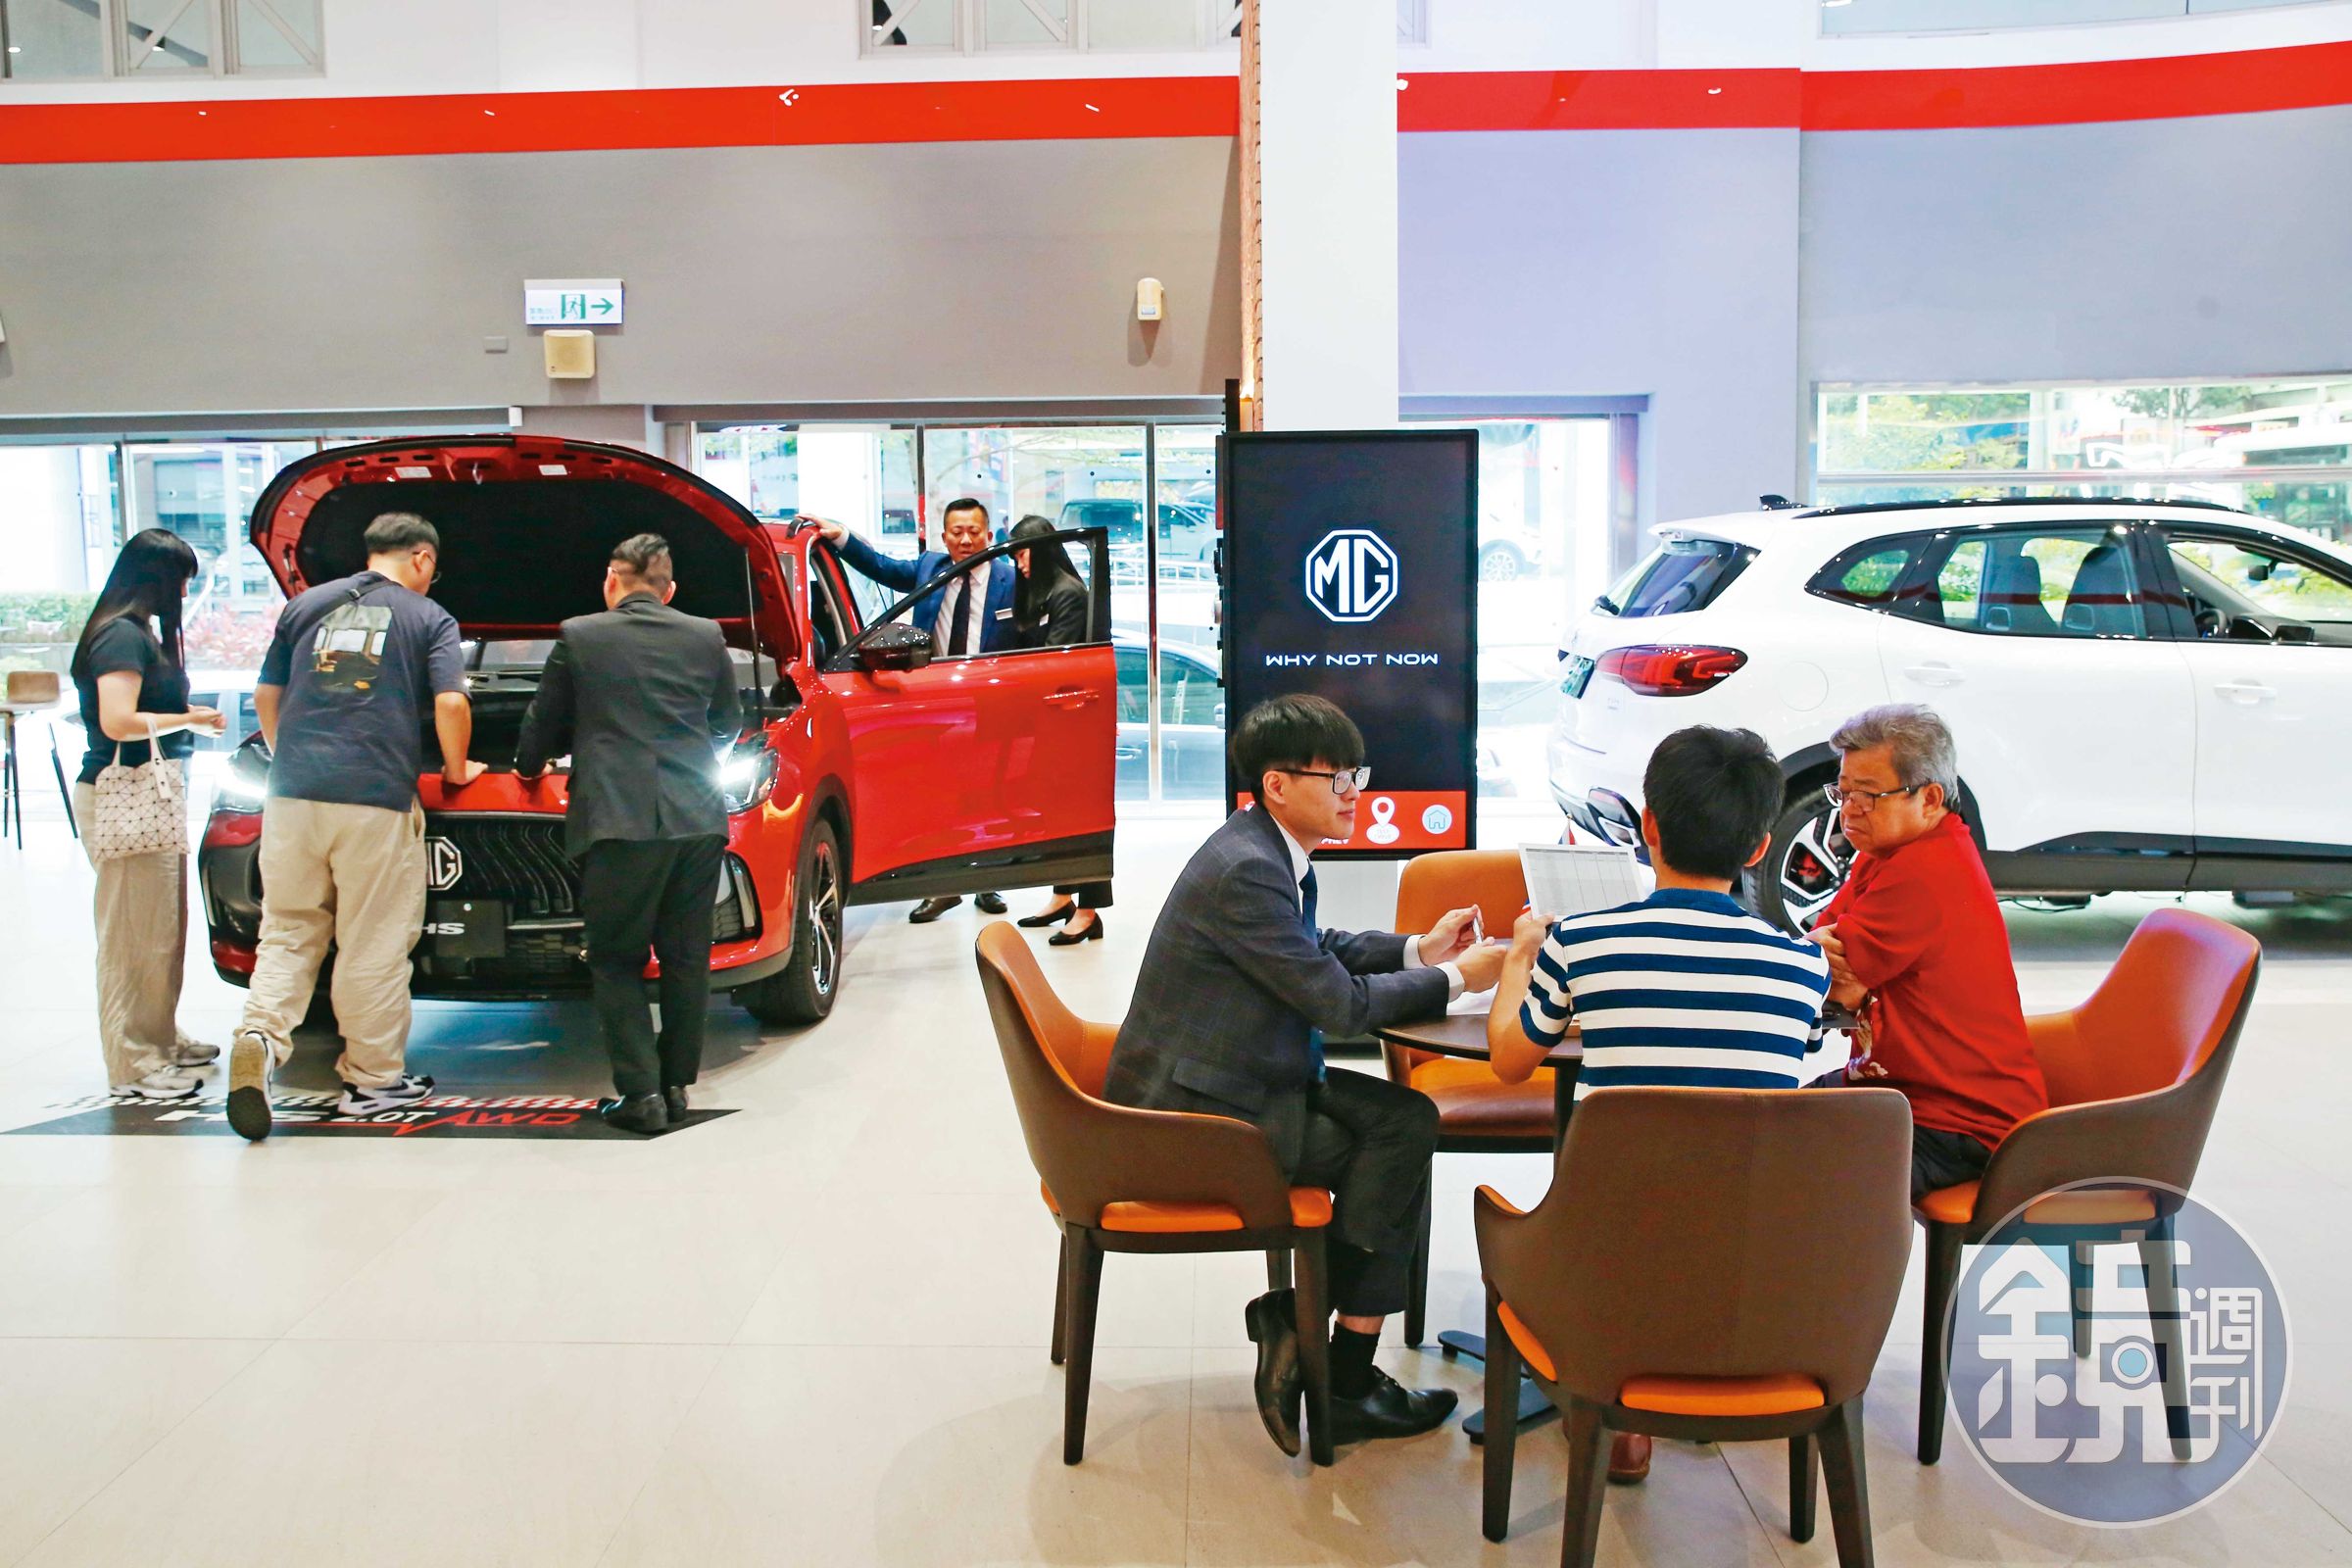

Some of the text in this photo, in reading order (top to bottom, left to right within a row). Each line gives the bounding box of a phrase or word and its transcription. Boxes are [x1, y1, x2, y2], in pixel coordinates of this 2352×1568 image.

[1313, 538, 1391, 614] MG
[1265, 653, 1439, 666] WHY NOT NOW
[439, 1109, 581, 1126] AWD
